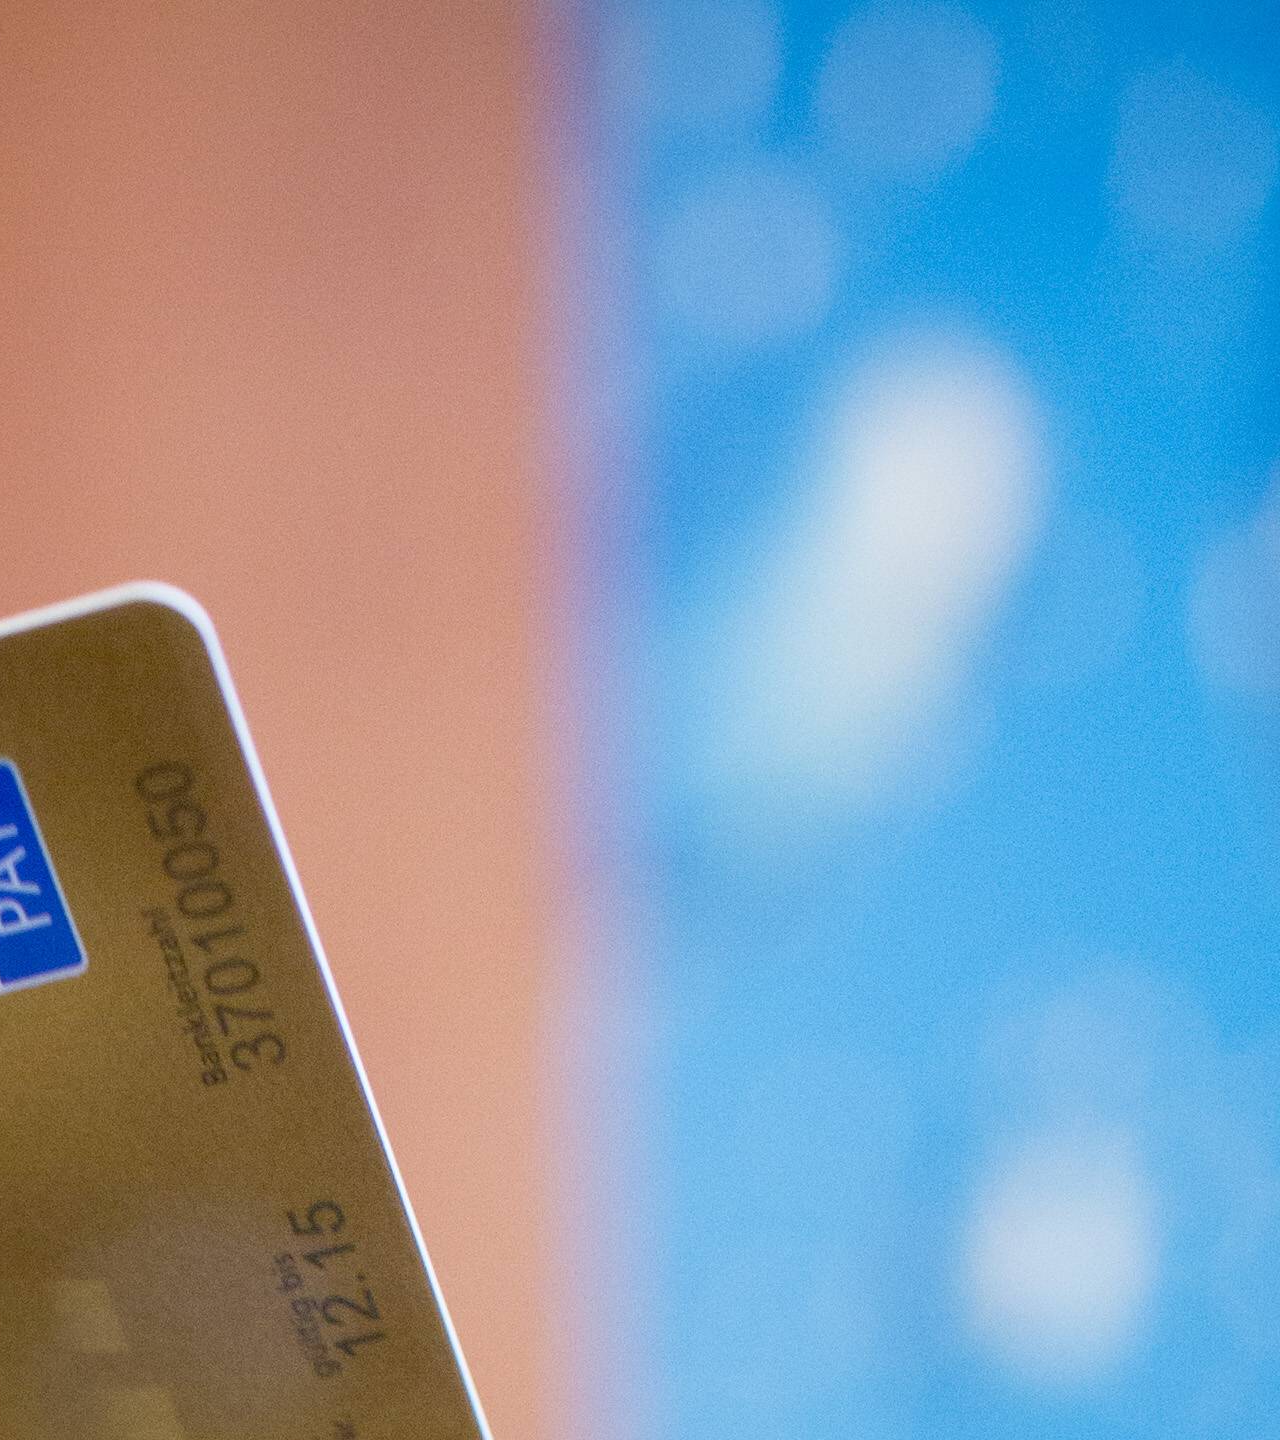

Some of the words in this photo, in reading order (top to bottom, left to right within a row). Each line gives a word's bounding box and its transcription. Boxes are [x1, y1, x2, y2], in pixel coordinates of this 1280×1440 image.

[135, 759, 288, 1073] 37010050
[143, 906, 229, 1087] Bankleitzahl
[286, 1198, 386, 1357] 12.15
